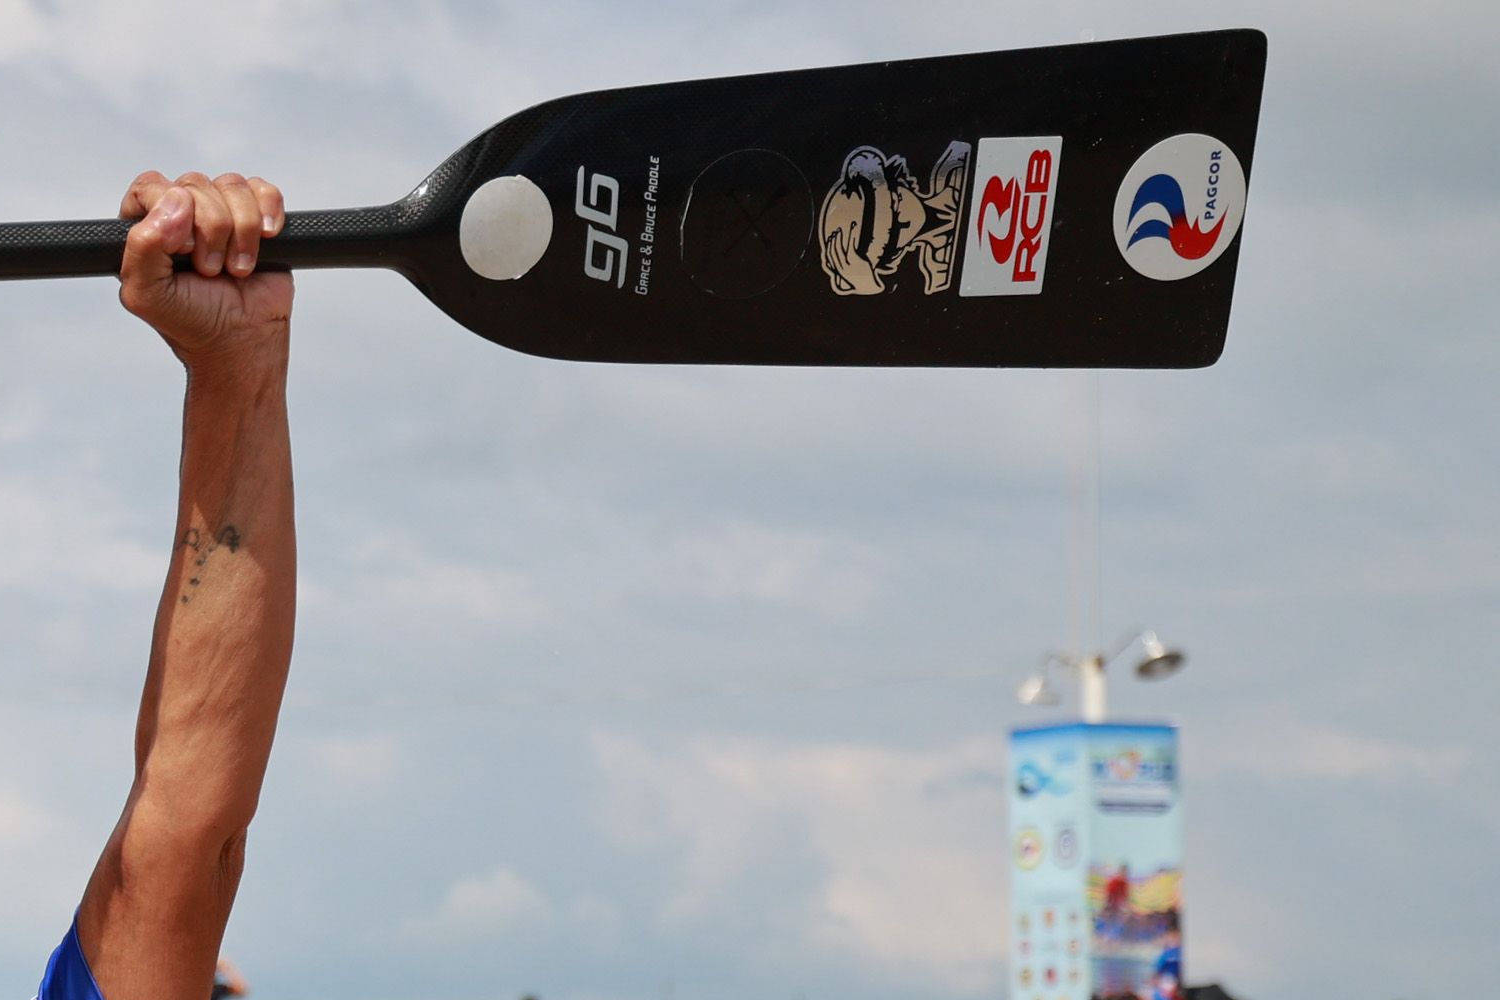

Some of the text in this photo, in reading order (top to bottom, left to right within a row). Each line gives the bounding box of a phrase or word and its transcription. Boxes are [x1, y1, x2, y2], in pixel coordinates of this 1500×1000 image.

[1012, 149, 1052, 282] RCB
[1204, 150, 1222, 220] PAGCOR
[640, 245, 653, 255] &
